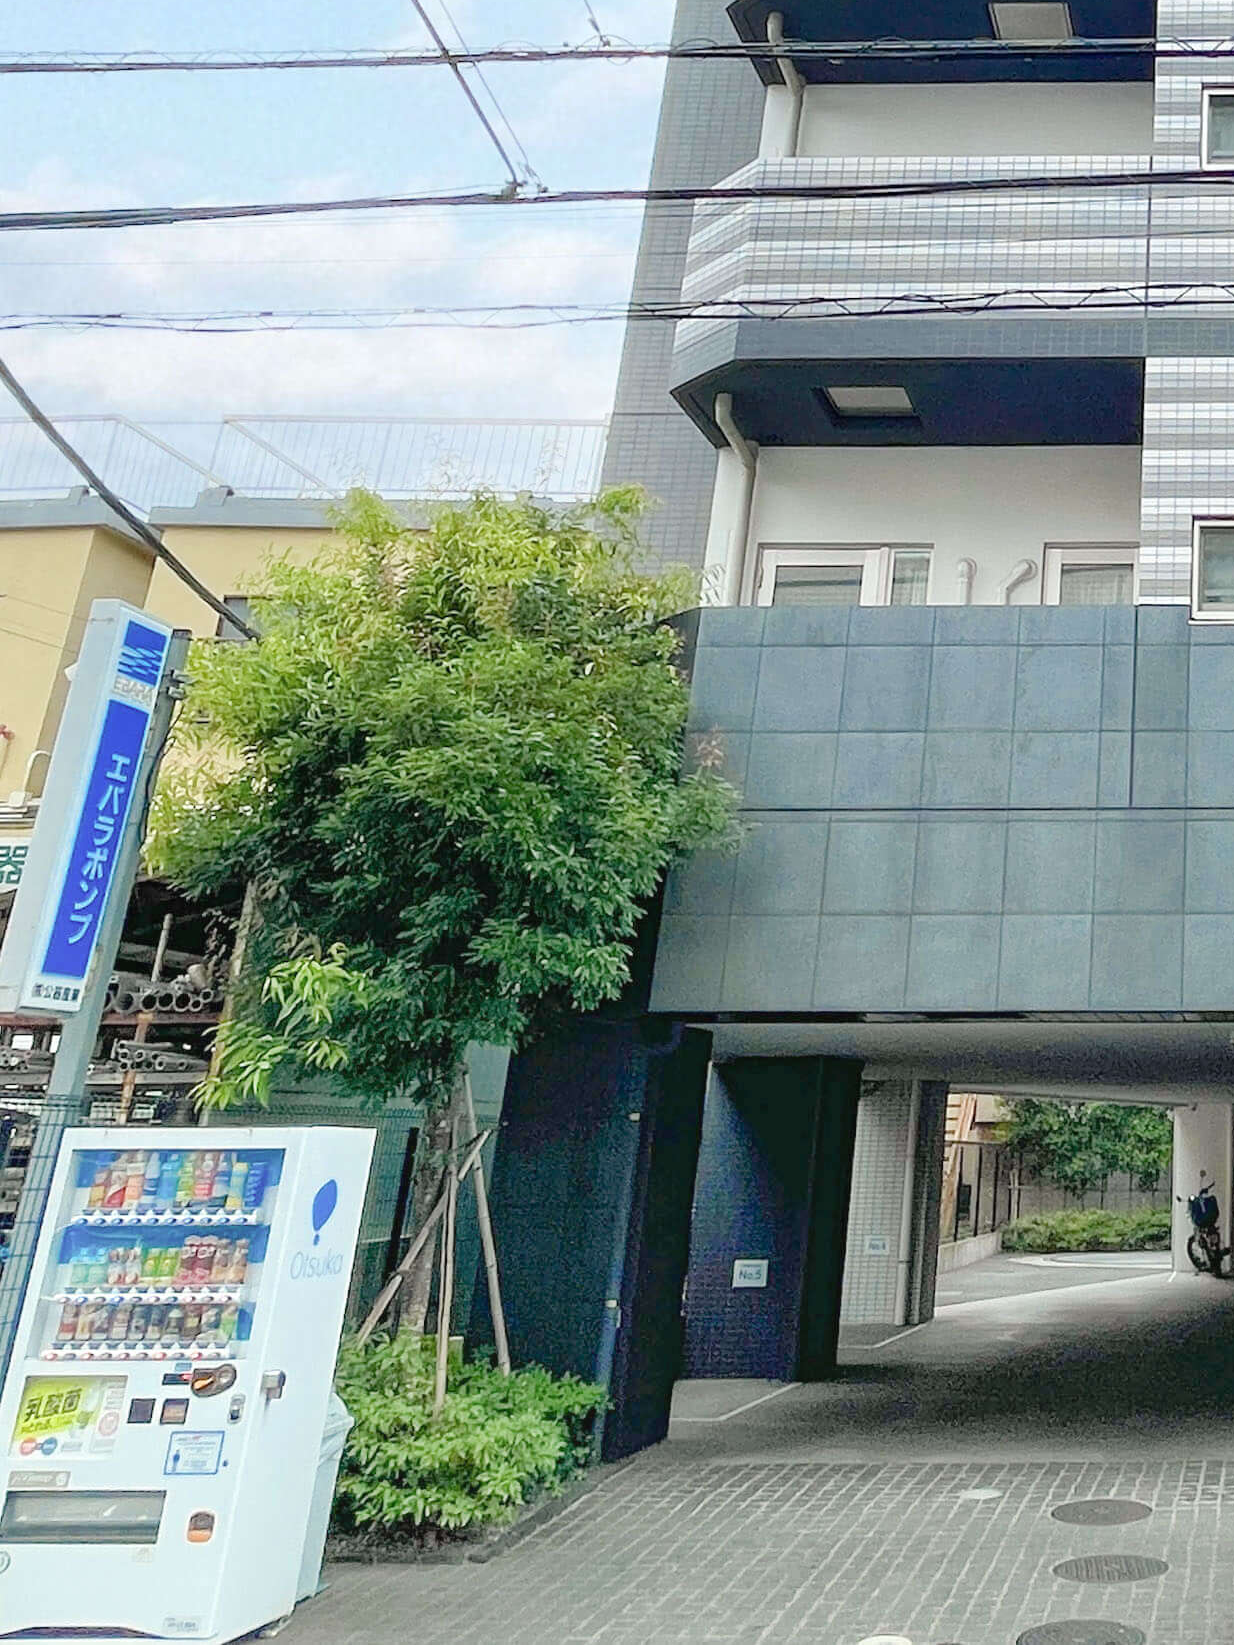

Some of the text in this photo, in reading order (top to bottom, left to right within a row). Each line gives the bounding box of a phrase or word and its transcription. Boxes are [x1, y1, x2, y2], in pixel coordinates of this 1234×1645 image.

[67, 753, 131, 945] エバラポンプ
